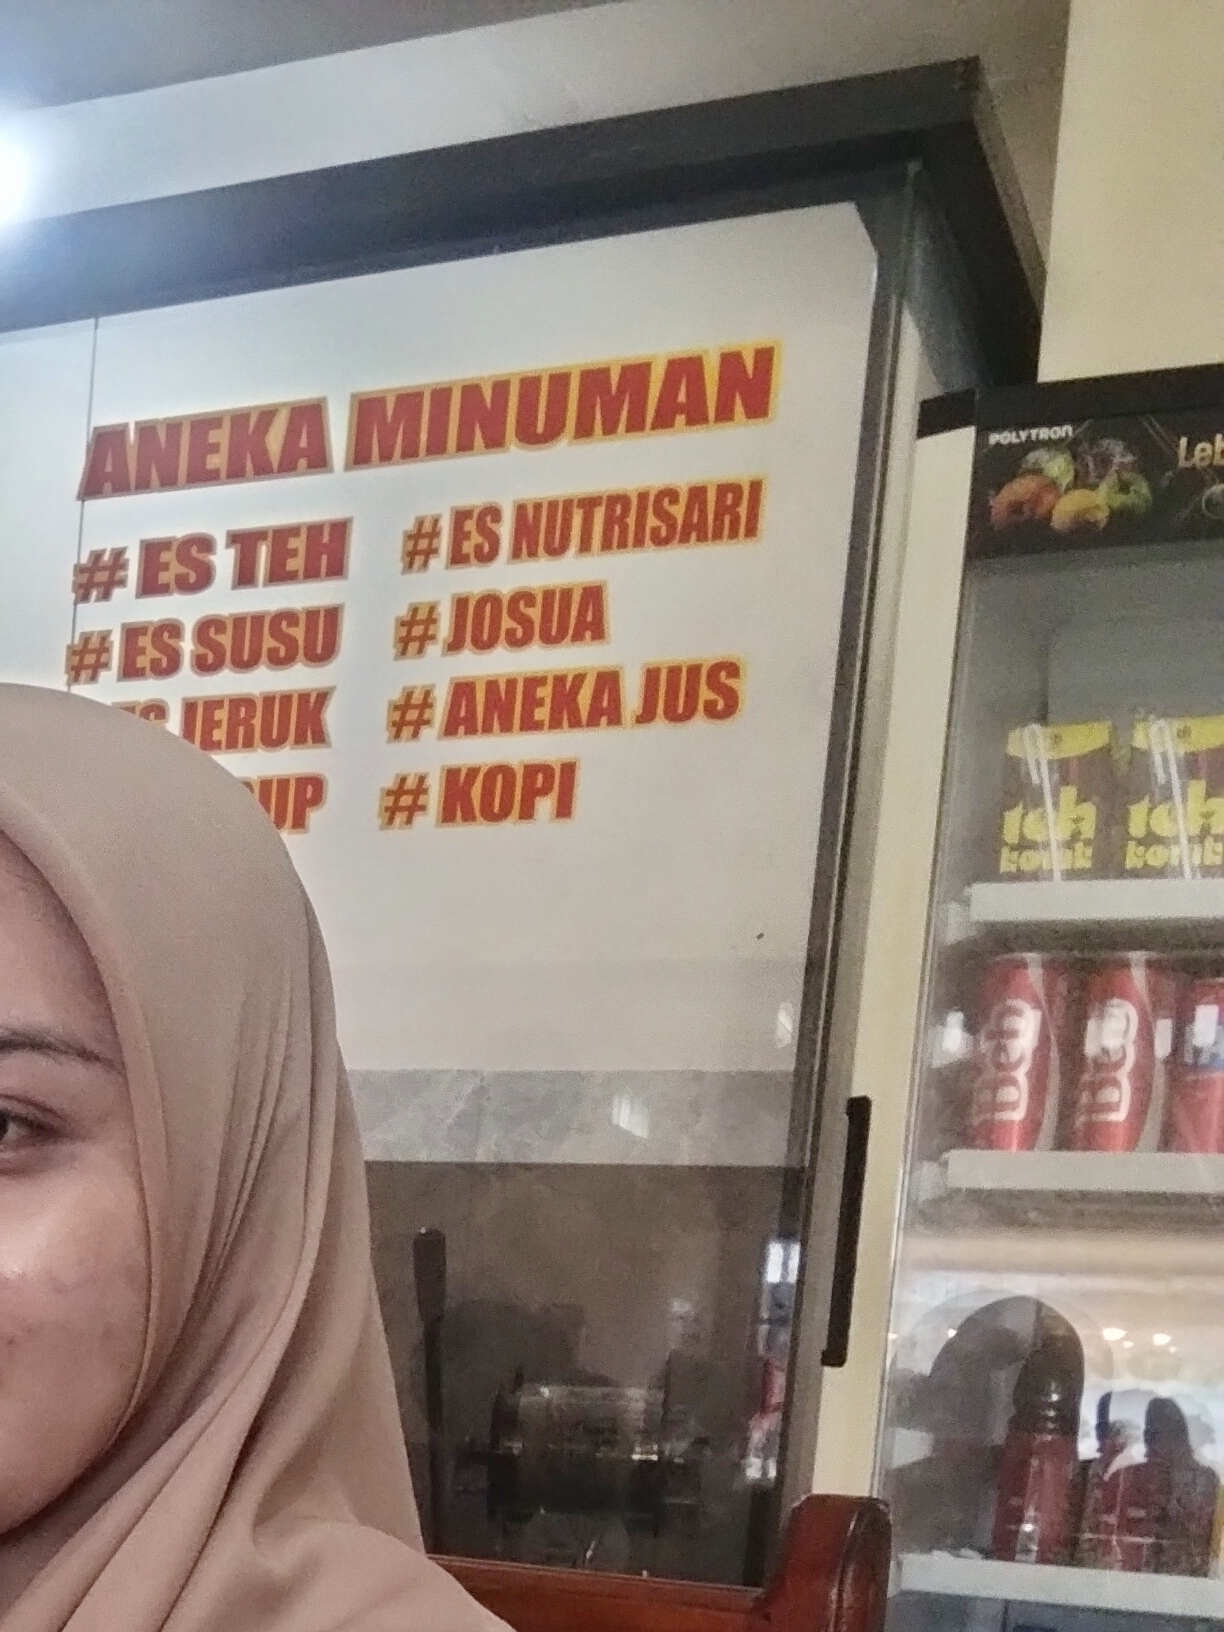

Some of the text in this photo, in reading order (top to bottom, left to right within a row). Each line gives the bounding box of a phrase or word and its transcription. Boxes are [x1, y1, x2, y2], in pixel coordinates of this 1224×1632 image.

[82, 345, 776, 494] ANEKA MINUMAN
[229, 519, 349, 587] TEH
[511, 479, 764, 561] NUTRISARI
[193, 607, 341, 675] SUSU
[445, 584, 607, 653] JOSUA
[441, 670, 624, 740] ANEKA
[633, 659, 742, 726] JUS
[438, 760, 579, 826] KOPI
